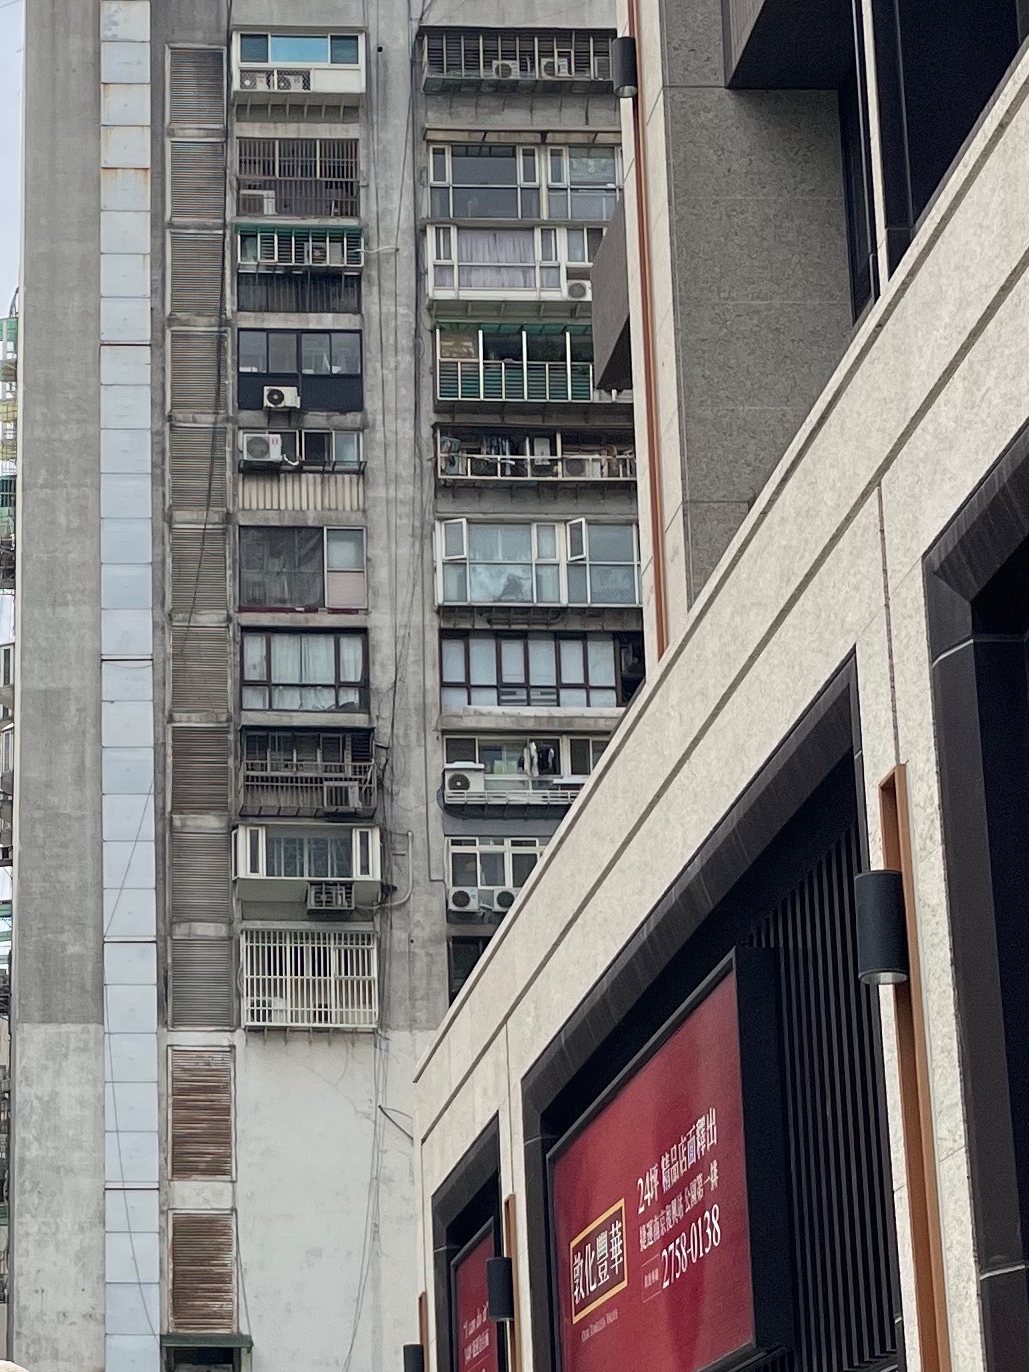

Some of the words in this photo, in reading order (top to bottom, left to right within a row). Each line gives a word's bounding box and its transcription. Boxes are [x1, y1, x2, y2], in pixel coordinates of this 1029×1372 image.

[637, 1163, 659, 1214] 24坪
[573, 1220, 623, 1305] 敦化豐華
[661, 1204, 721, 1289] 2758-0138
